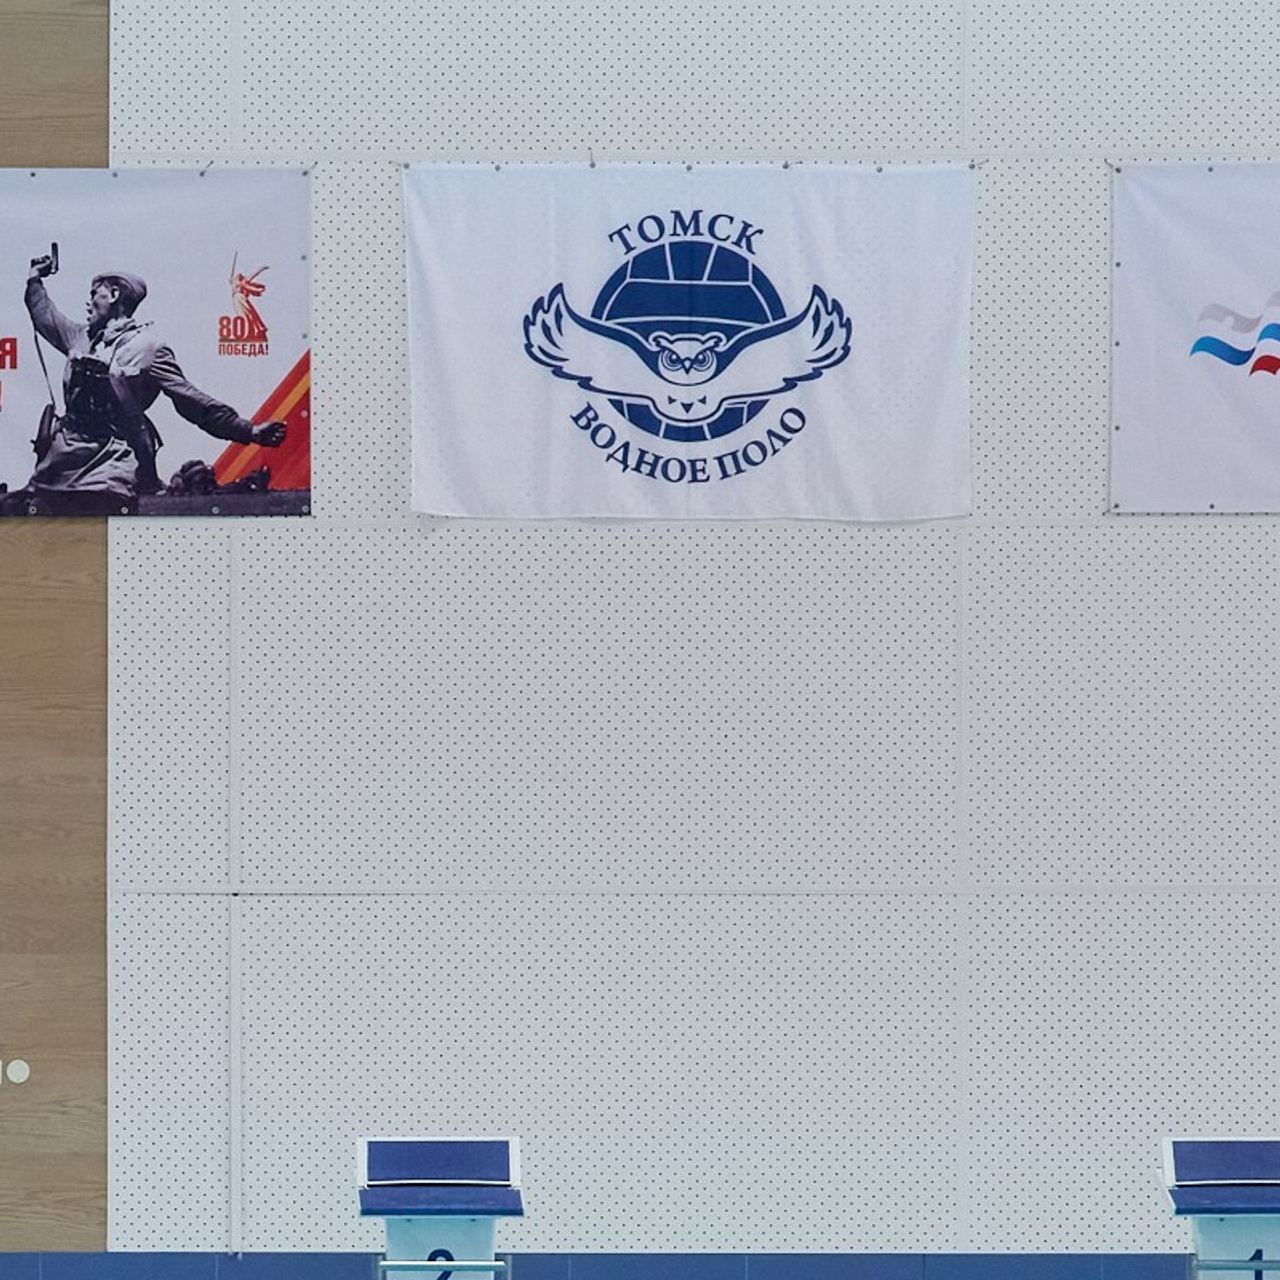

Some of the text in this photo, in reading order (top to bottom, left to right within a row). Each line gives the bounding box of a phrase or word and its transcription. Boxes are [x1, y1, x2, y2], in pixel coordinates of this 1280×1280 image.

[608, 209, 765, 256] ТОМСК
[218, 315, 246, 339] 80
[218, 343, 269, 358] ПОБЕДА!
[569, 401, 807, 485] ВОДНОЕ ПОЛО
